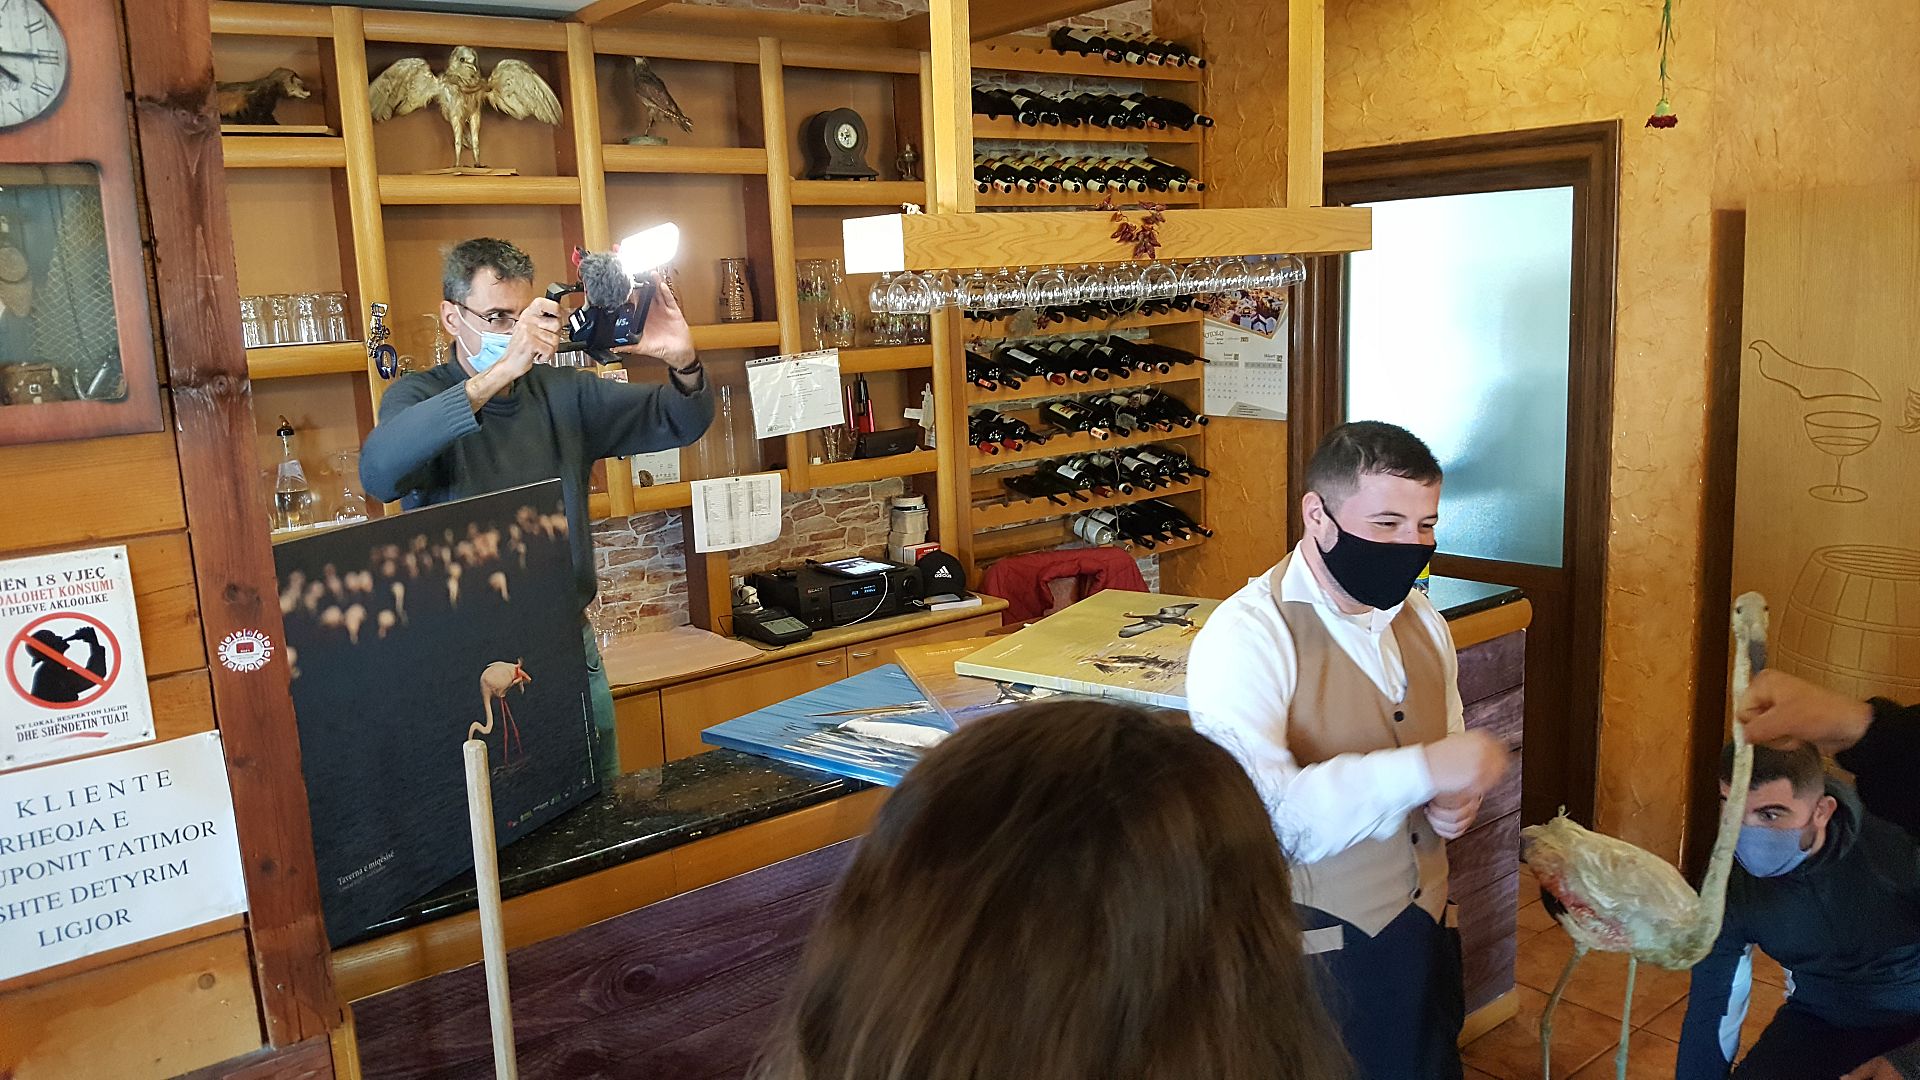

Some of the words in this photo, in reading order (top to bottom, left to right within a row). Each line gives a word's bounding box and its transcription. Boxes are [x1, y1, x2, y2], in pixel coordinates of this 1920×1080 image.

[36, 574, 56, 587] 18
[62, 566, 106, 582] VJEÇ
[58, 579, 114, 598] KONSUMI
[1, 608, 6, 617] I
[9, 602, 47, 616] PIJEVE
[50, 593, 109, 610] AKLOOLIKE
[17, 729, 39, 742] DHE
[41, 716, 98, 738] SHËNDETIN
[100, 711, 129, 726] TUAJ!
[28, 718, 54, 728] LOKAL
[57, 709, 102, 722] RESPEKTON
[16, 769, 173, 819] KLIENTE
[112, 810, 130, 829] E
[98, 820, 218, 862] TATIMOR
[71, 859, 190, 905] DETYRIM
[38, 908, 132, 948] LIGJOR
